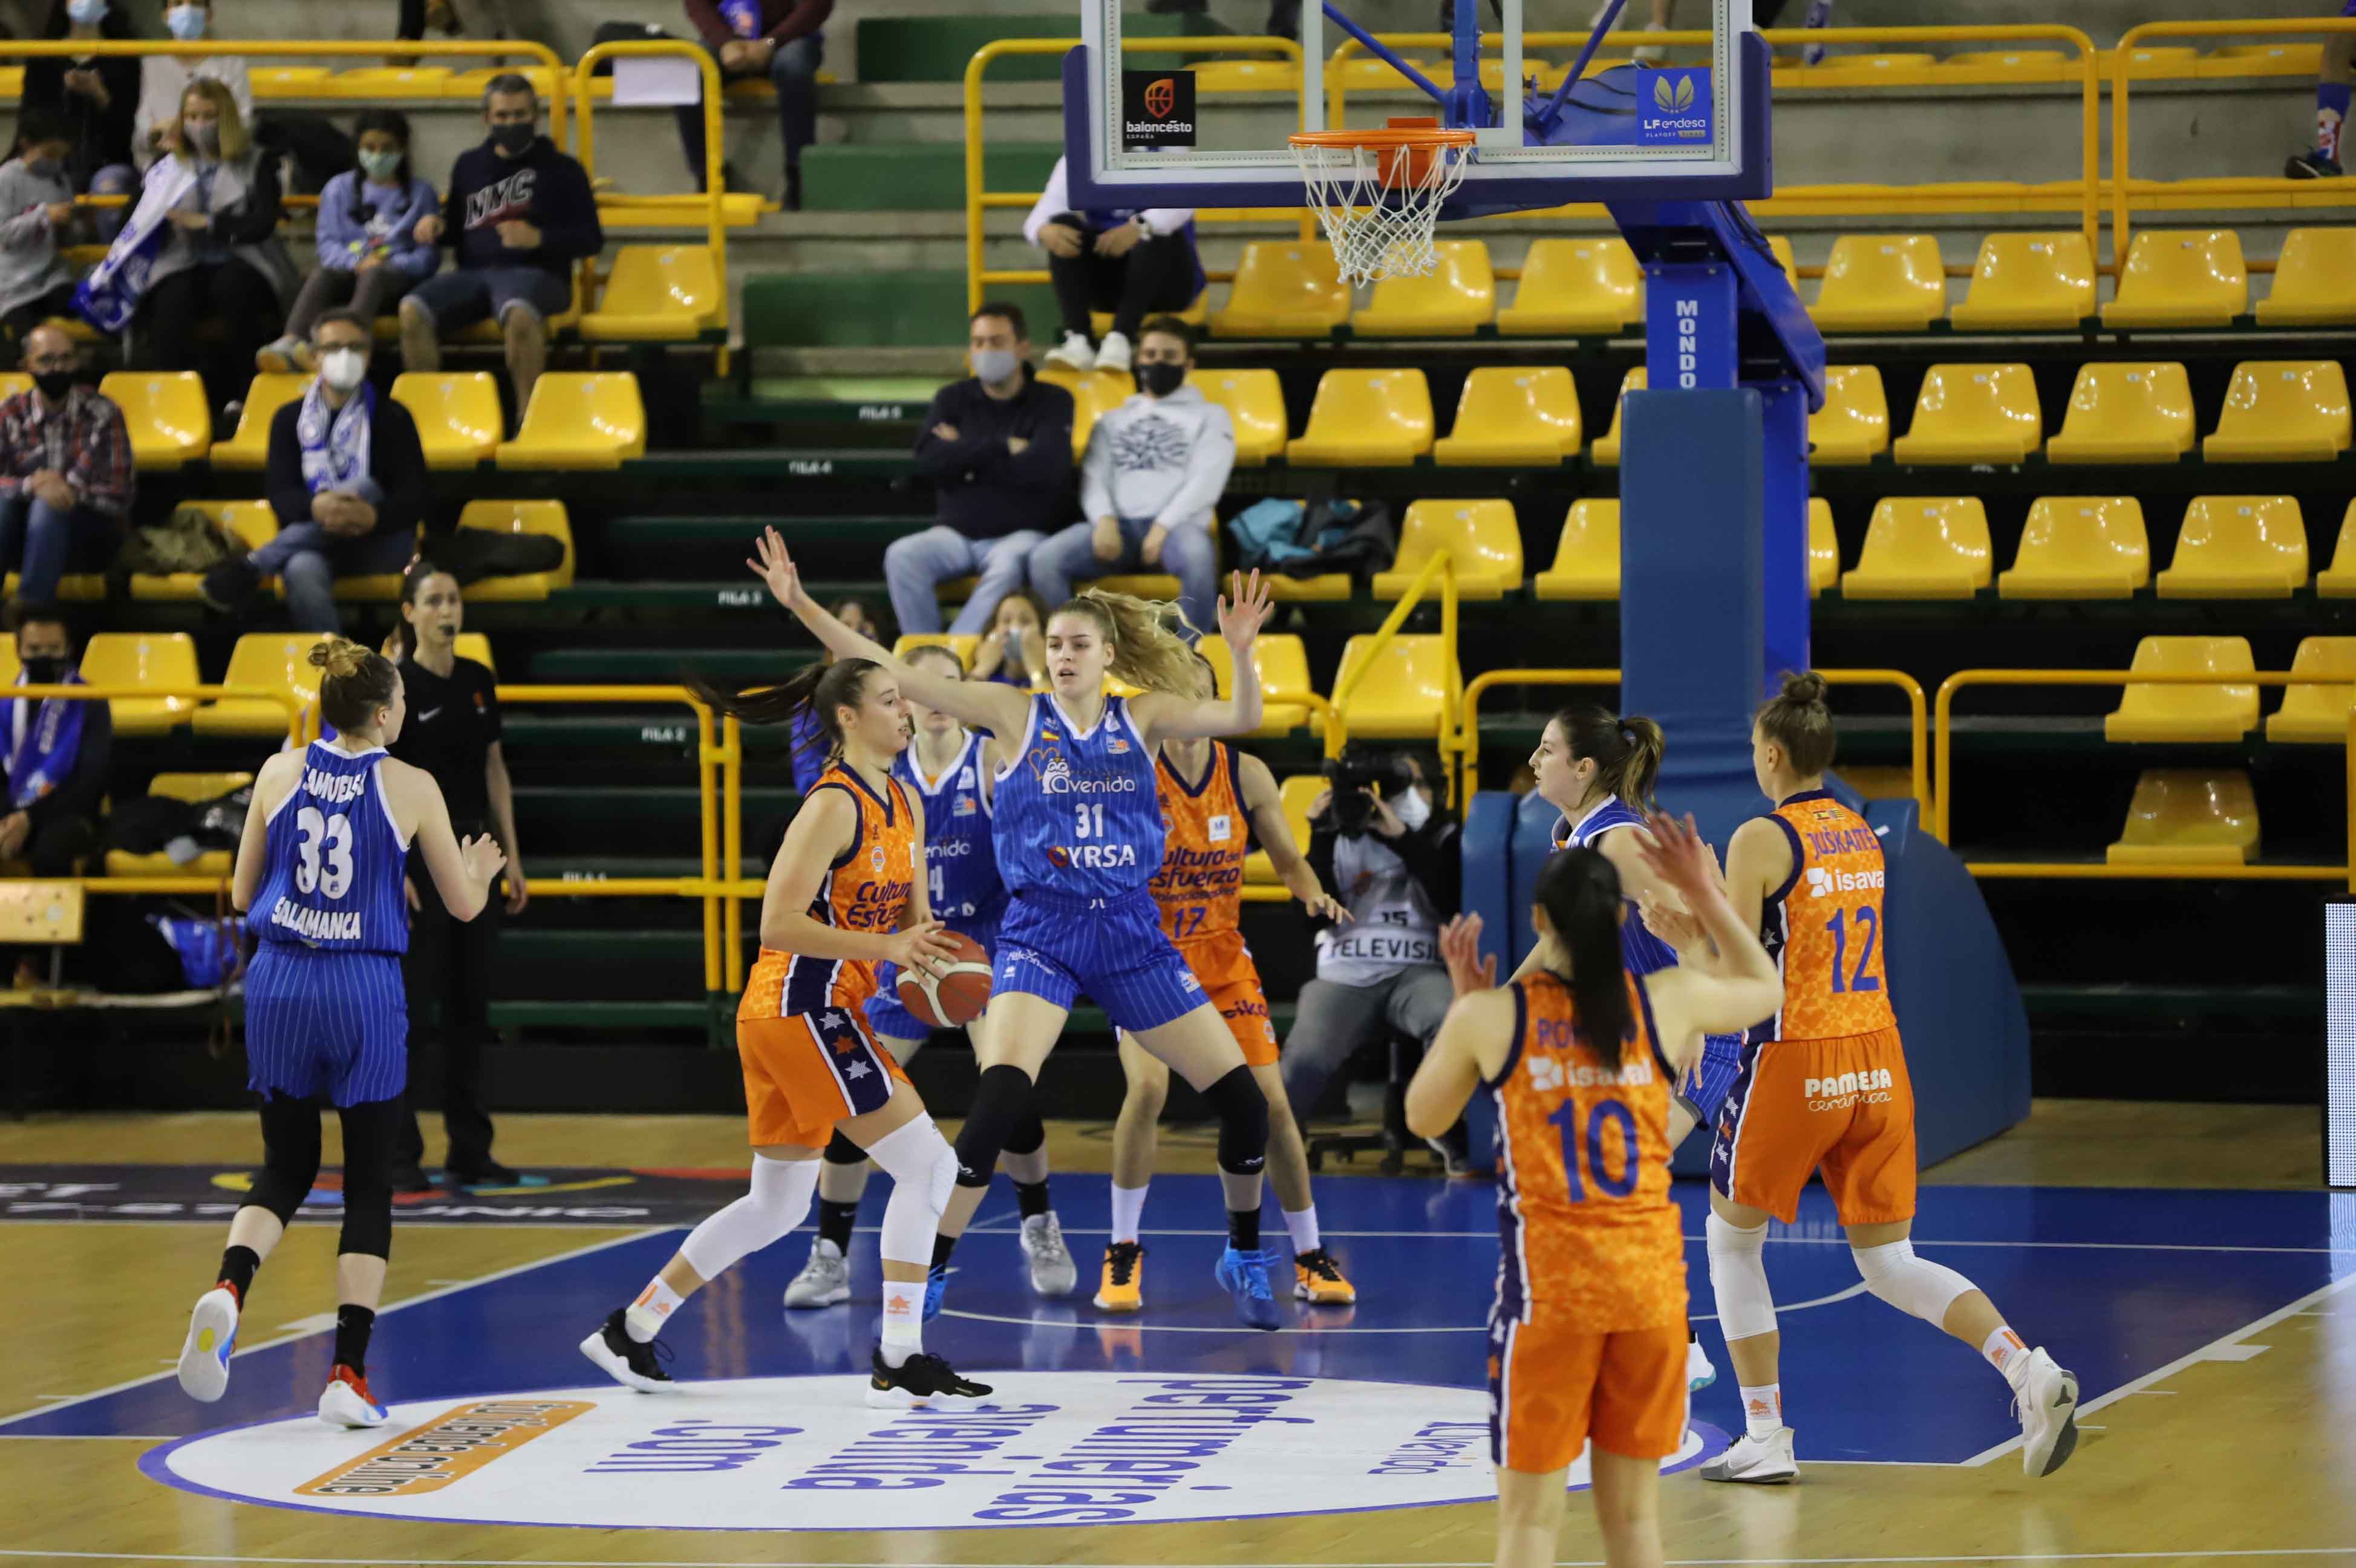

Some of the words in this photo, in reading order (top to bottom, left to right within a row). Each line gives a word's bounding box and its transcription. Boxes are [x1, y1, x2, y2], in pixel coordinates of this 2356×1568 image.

[1126, 120, 1192, 132] baloncesto
[1662, 118, 1706, 128] endesa
[1676, 299, 1698, 389] MONDO
[718, 590, 749, 606] FILA
[641, 727, 673, 742] FILA
[1075, 803, 1103, 838] 31
[296, 806, 354, 900] 33
[271, 896, 362, 940] SALAMANCA
[1173, 906, 1206, 938] 17
[1826, 906, 1881, 993] 12
[1805, 1068, 1893, 1098] PAMESA
[1548, 1097, 1639, 1204] 10
[313, 1454, 455, 1495] online
